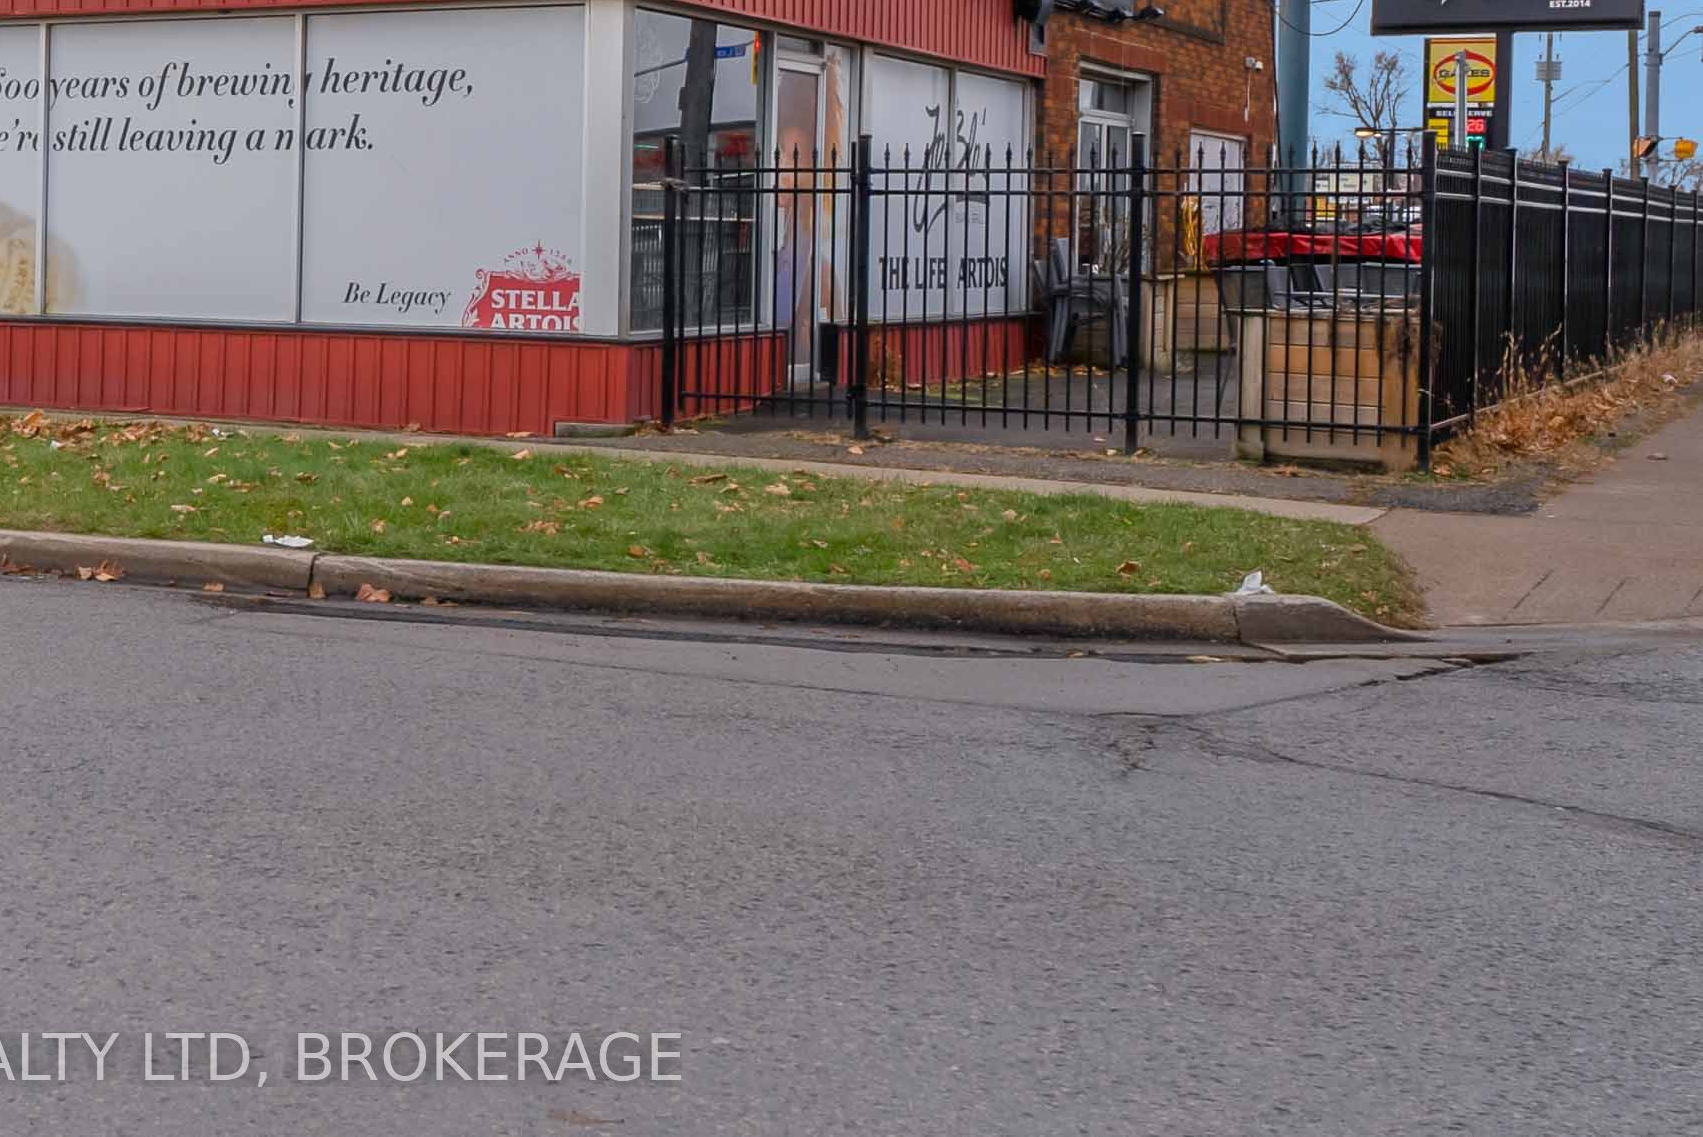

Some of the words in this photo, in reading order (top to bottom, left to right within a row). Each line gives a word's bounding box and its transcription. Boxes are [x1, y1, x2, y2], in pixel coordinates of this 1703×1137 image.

[49, 73, 130, 111] years
[138, 62, 177, 110] of
[320, 58, 474, 106] heritage,
[53, 117, 114, 151] still
[118, 117, 237, 164] leaving
[246, 128, 265, 150] a
[342, 281, 371, 304] Be
[375, 282, 451, 314] Legacy
